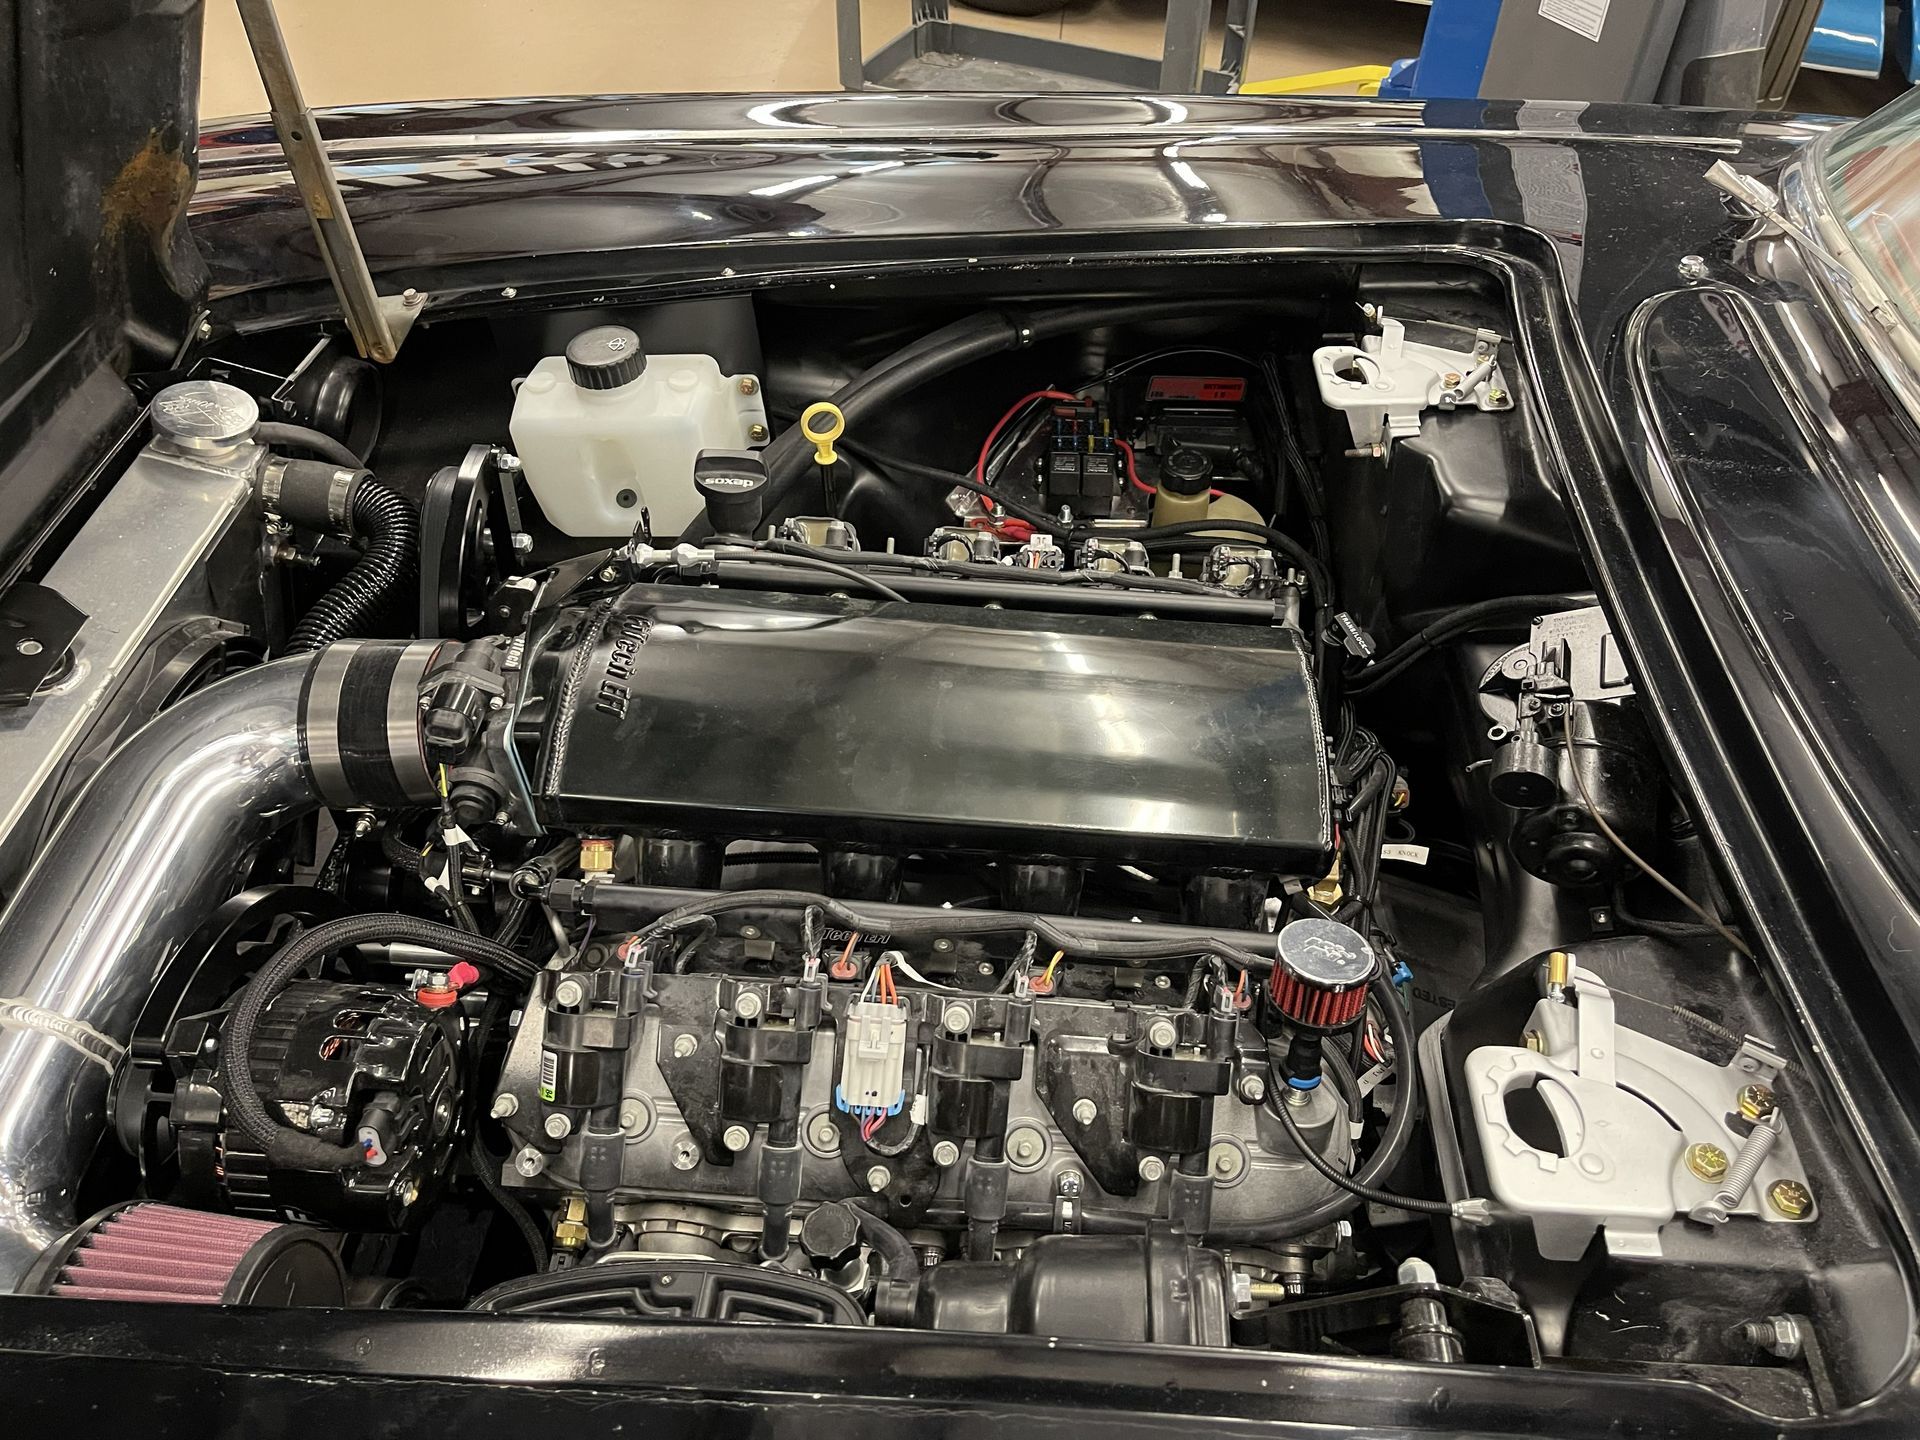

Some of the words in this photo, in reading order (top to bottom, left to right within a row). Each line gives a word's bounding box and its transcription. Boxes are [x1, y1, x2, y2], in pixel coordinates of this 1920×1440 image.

[704, 477, 754, 488] dexos
[1340, 613, 1368, 649] TRANS/LOCK
[504, 638, 525, 667] FiTech
[595, 679, 631, 720] EFI
[1398, 850, 1419, 858] KNOCK
[1412, 987, 1456, 1010] ESTED
